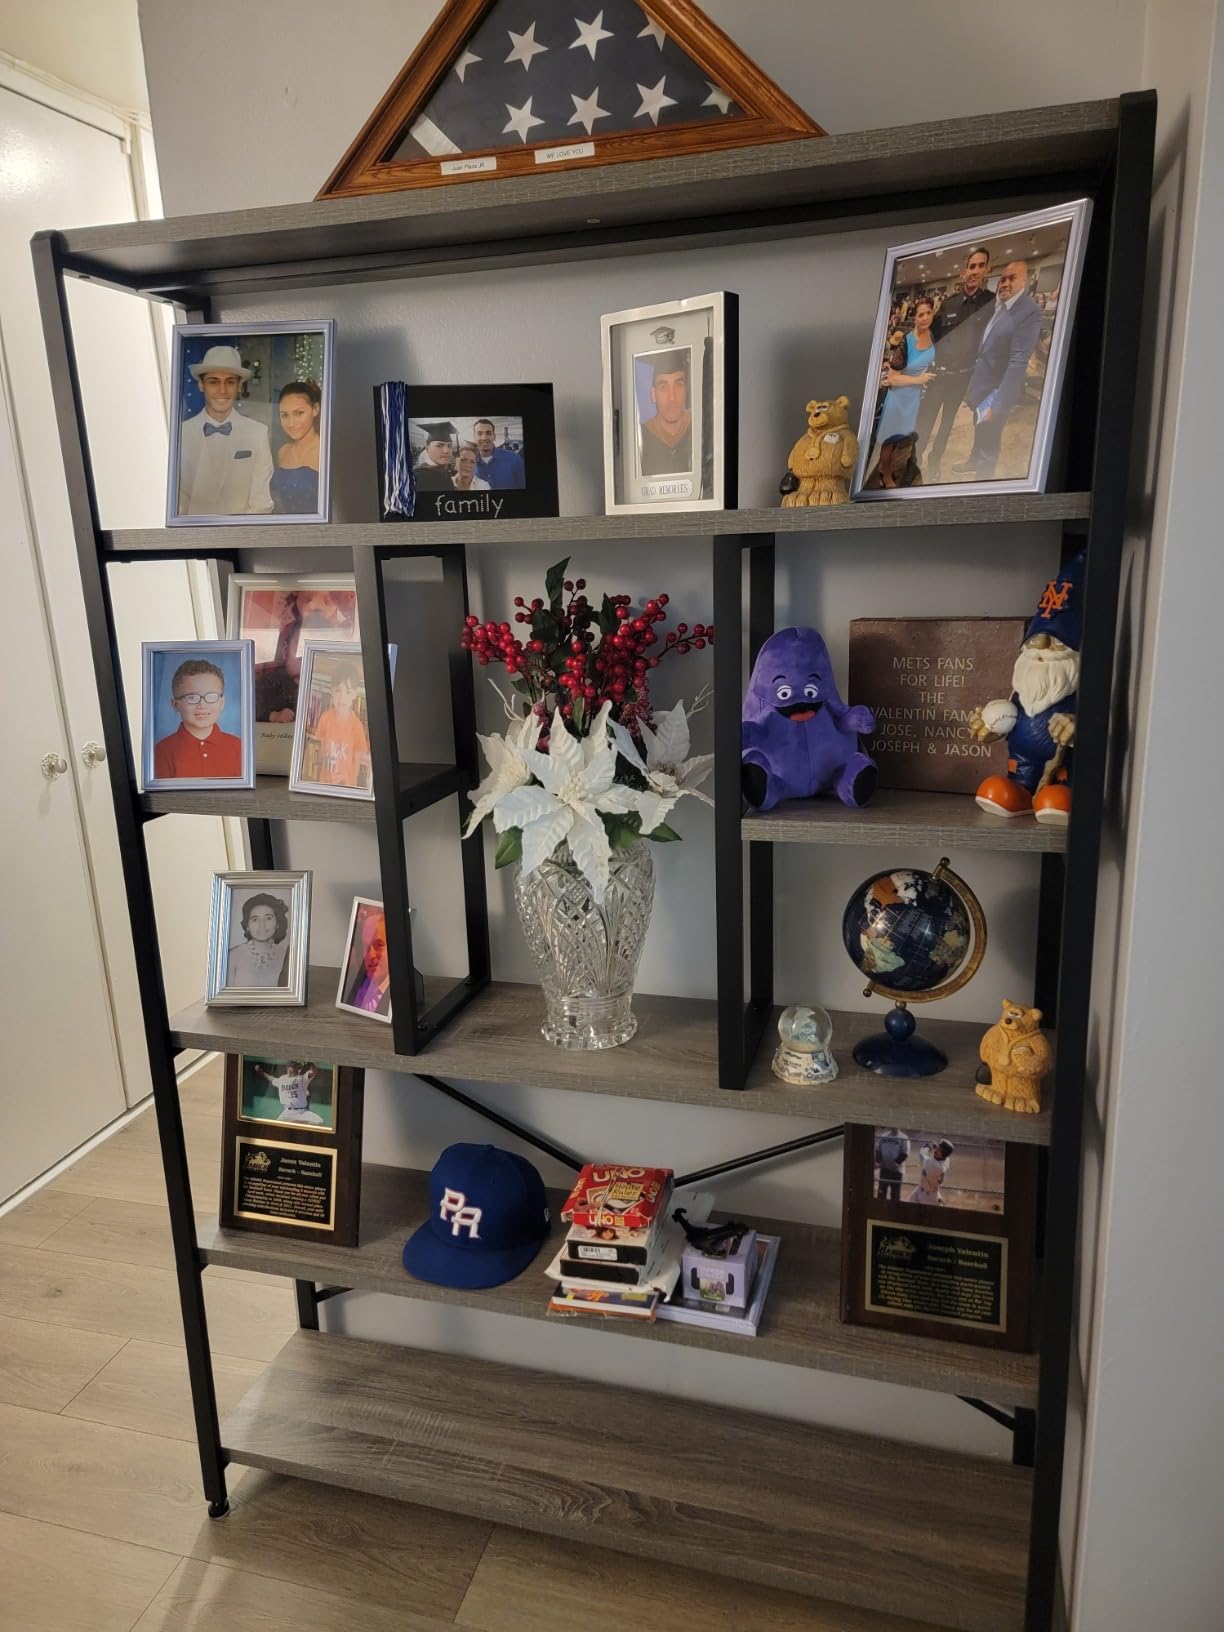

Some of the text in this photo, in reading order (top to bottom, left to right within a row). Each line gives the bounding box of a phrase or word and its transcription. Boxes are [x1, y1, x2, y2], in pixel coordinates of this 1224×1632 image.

[556, 150, 571, 159] LOVE
[572, 148, 584, 156] YOU
[659, 483, 689, 496] MEMORIES
[434, 493, 504, 518] family
[893, 656, 974, 671] METS FANS
[900, 674, 966, 688] FOR LIFE!
[919, 691, 945, 704] THE
[870, 706, 974, 722] VALENTIN FAM
[871, 739, 992, 757] JOSEPH & JASON
[593, 1168, 645, 1182] UNO
[588, 1214, 614, 1226] UNO
